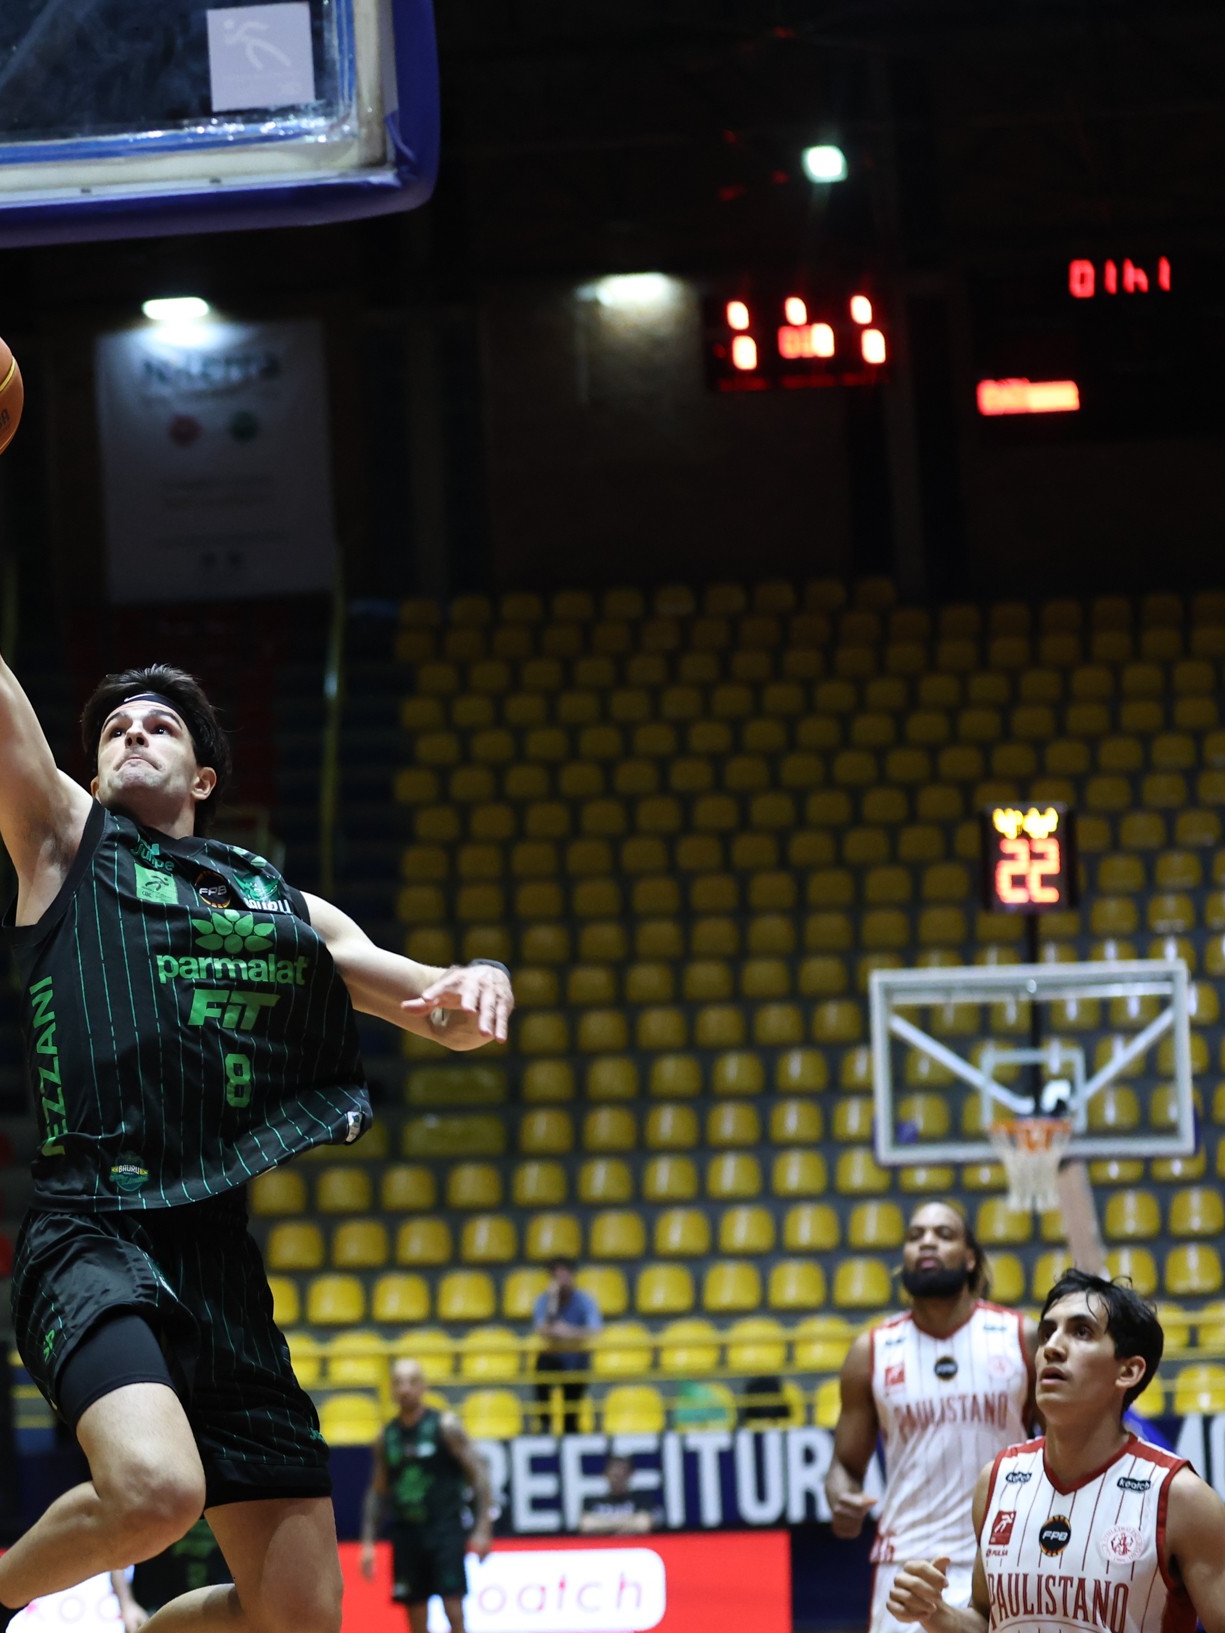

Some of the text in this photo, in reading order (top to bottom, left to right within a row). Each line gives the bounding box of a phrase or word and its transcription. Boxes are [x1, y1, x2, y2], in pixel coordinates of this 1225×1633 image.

[199, 885, 227, 897] FPB
[995, 838, 1060, 903] 22
[156, 954, 309, 985] parmalat
[225, 1052, 252, 1109] 8
[1042, 1531, 1068, 1542] FPB
[477, 1571, 643, 1617] oatch
[987, 1572, 1130, 1633] PAULISTANO
